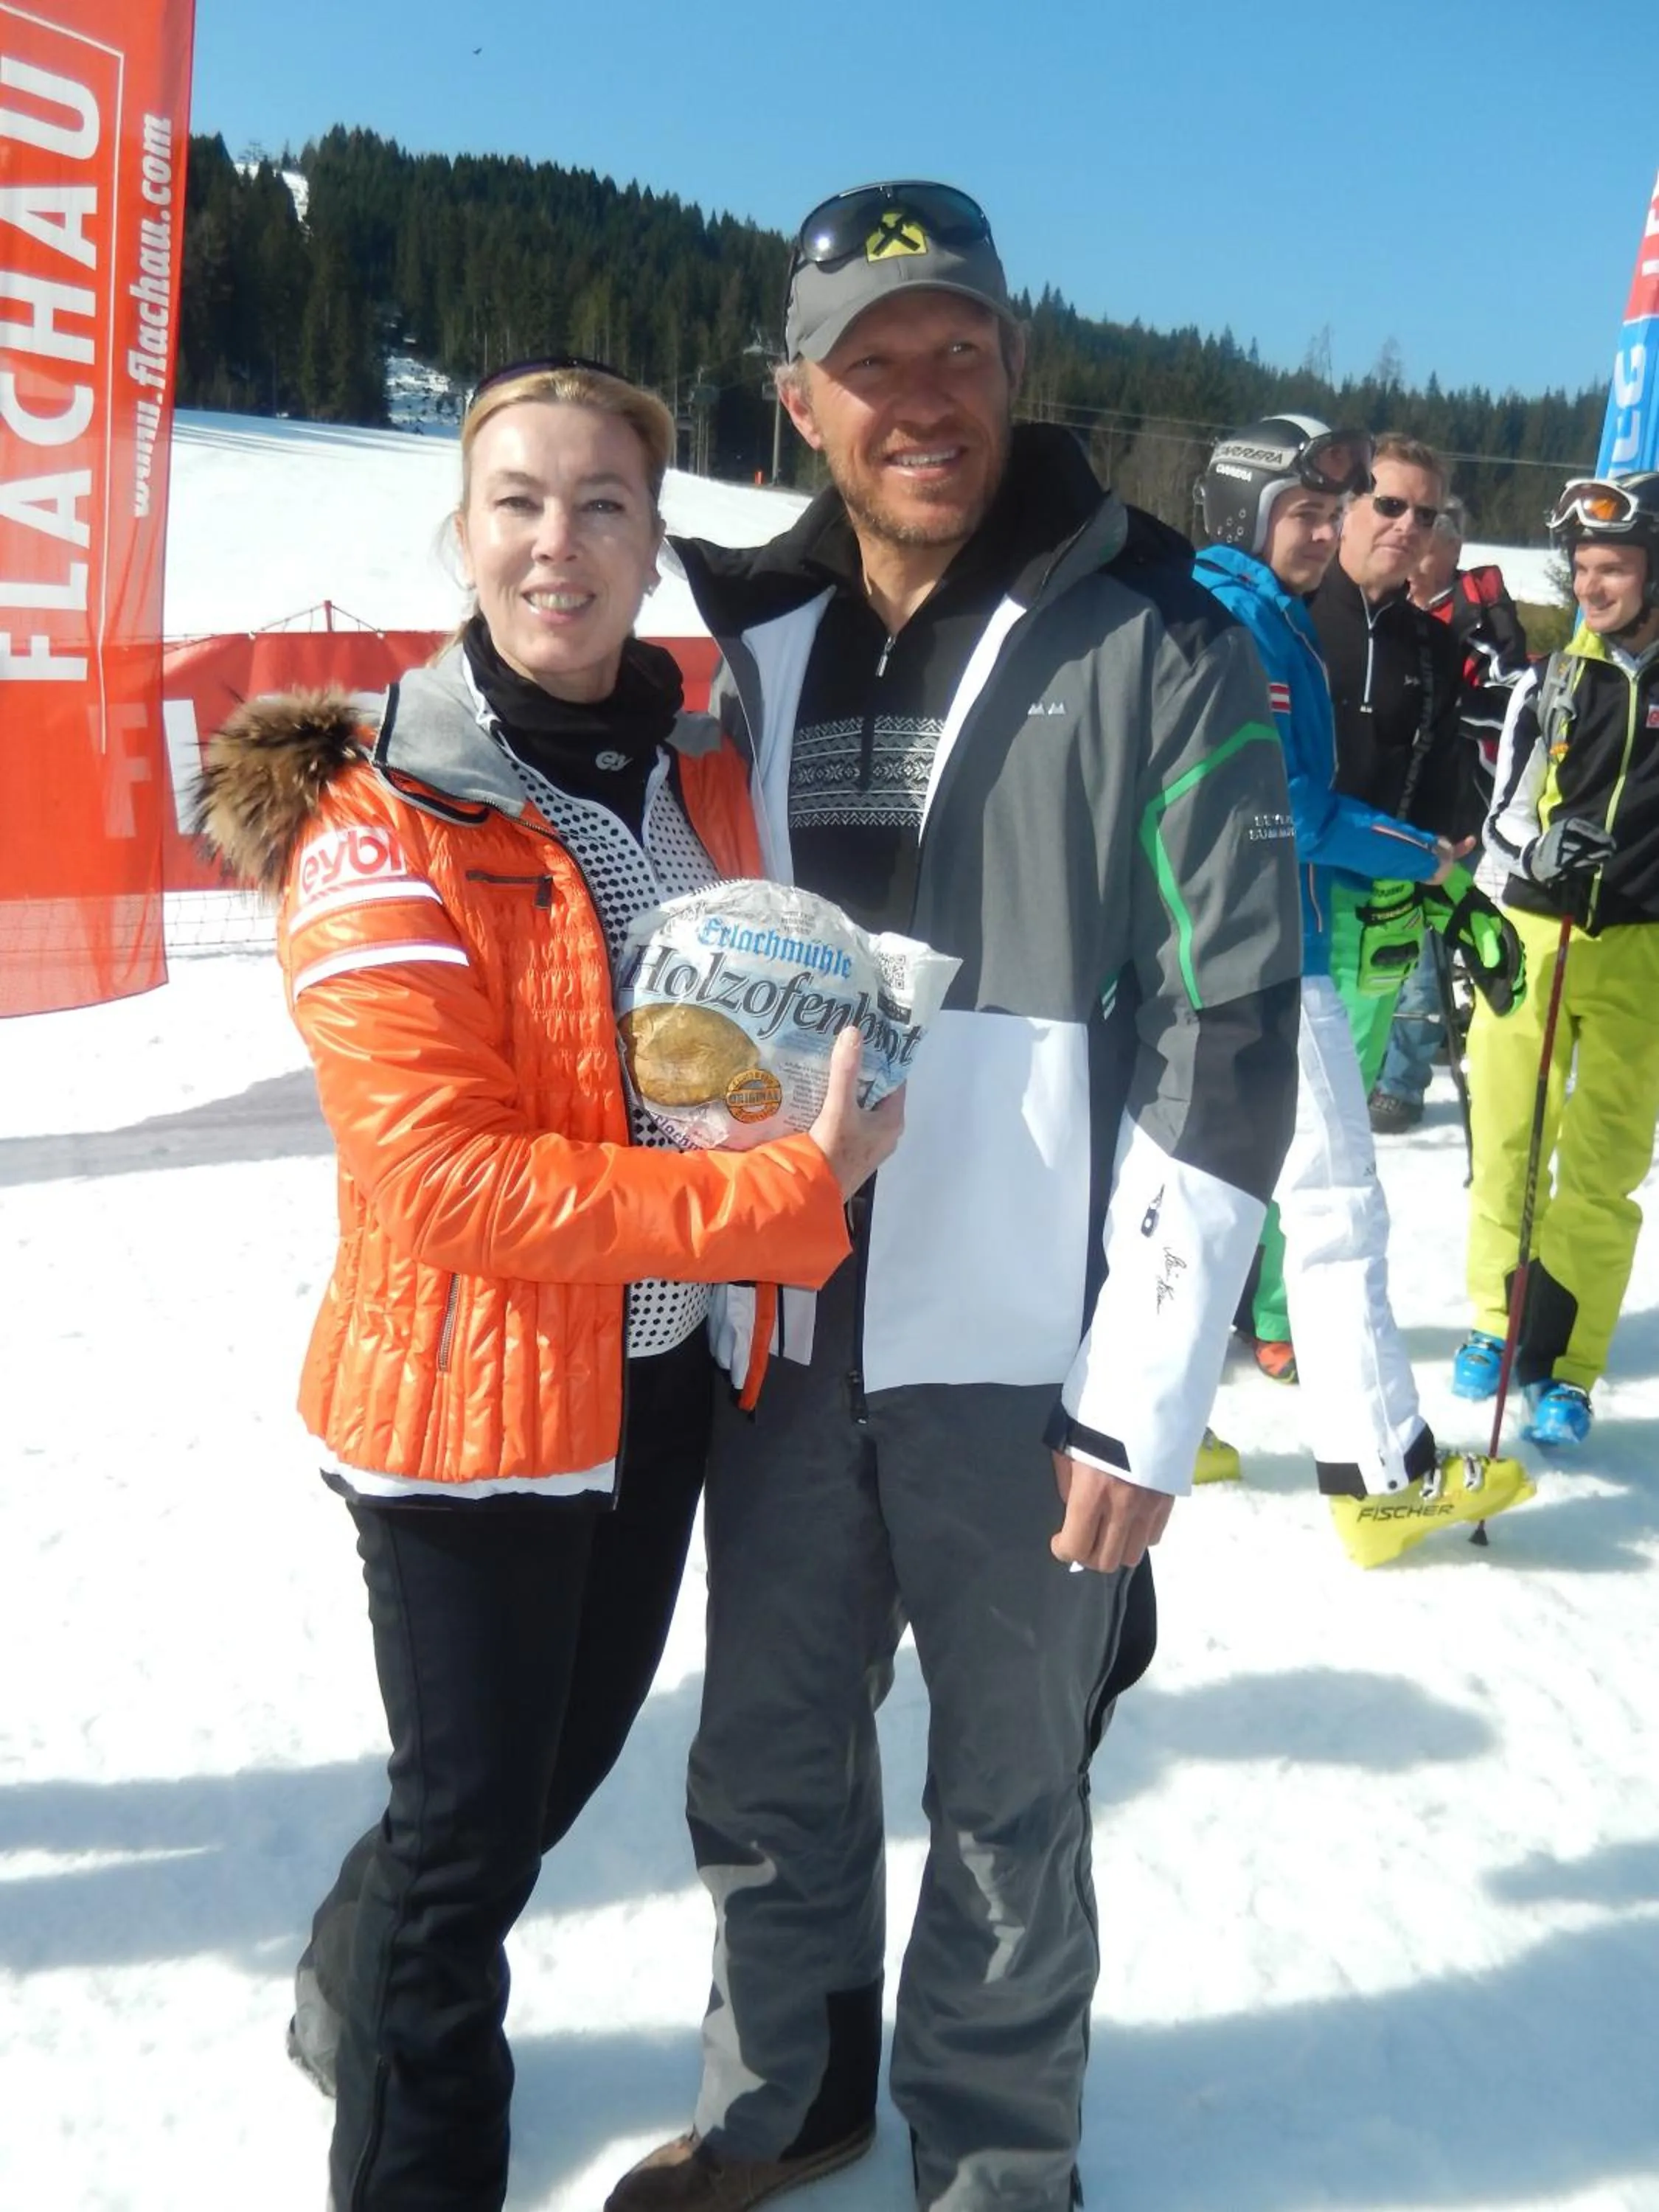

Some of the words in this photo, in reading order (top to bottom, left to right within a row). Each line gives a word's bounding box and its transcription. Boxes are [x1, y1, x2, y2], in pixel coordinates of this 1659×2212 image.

[0, 57, 100, 681] FLACHAU
[698, 917, 852, 979] Erlachmühle
[1357, 1503, 1455, 1523] FISCHER
